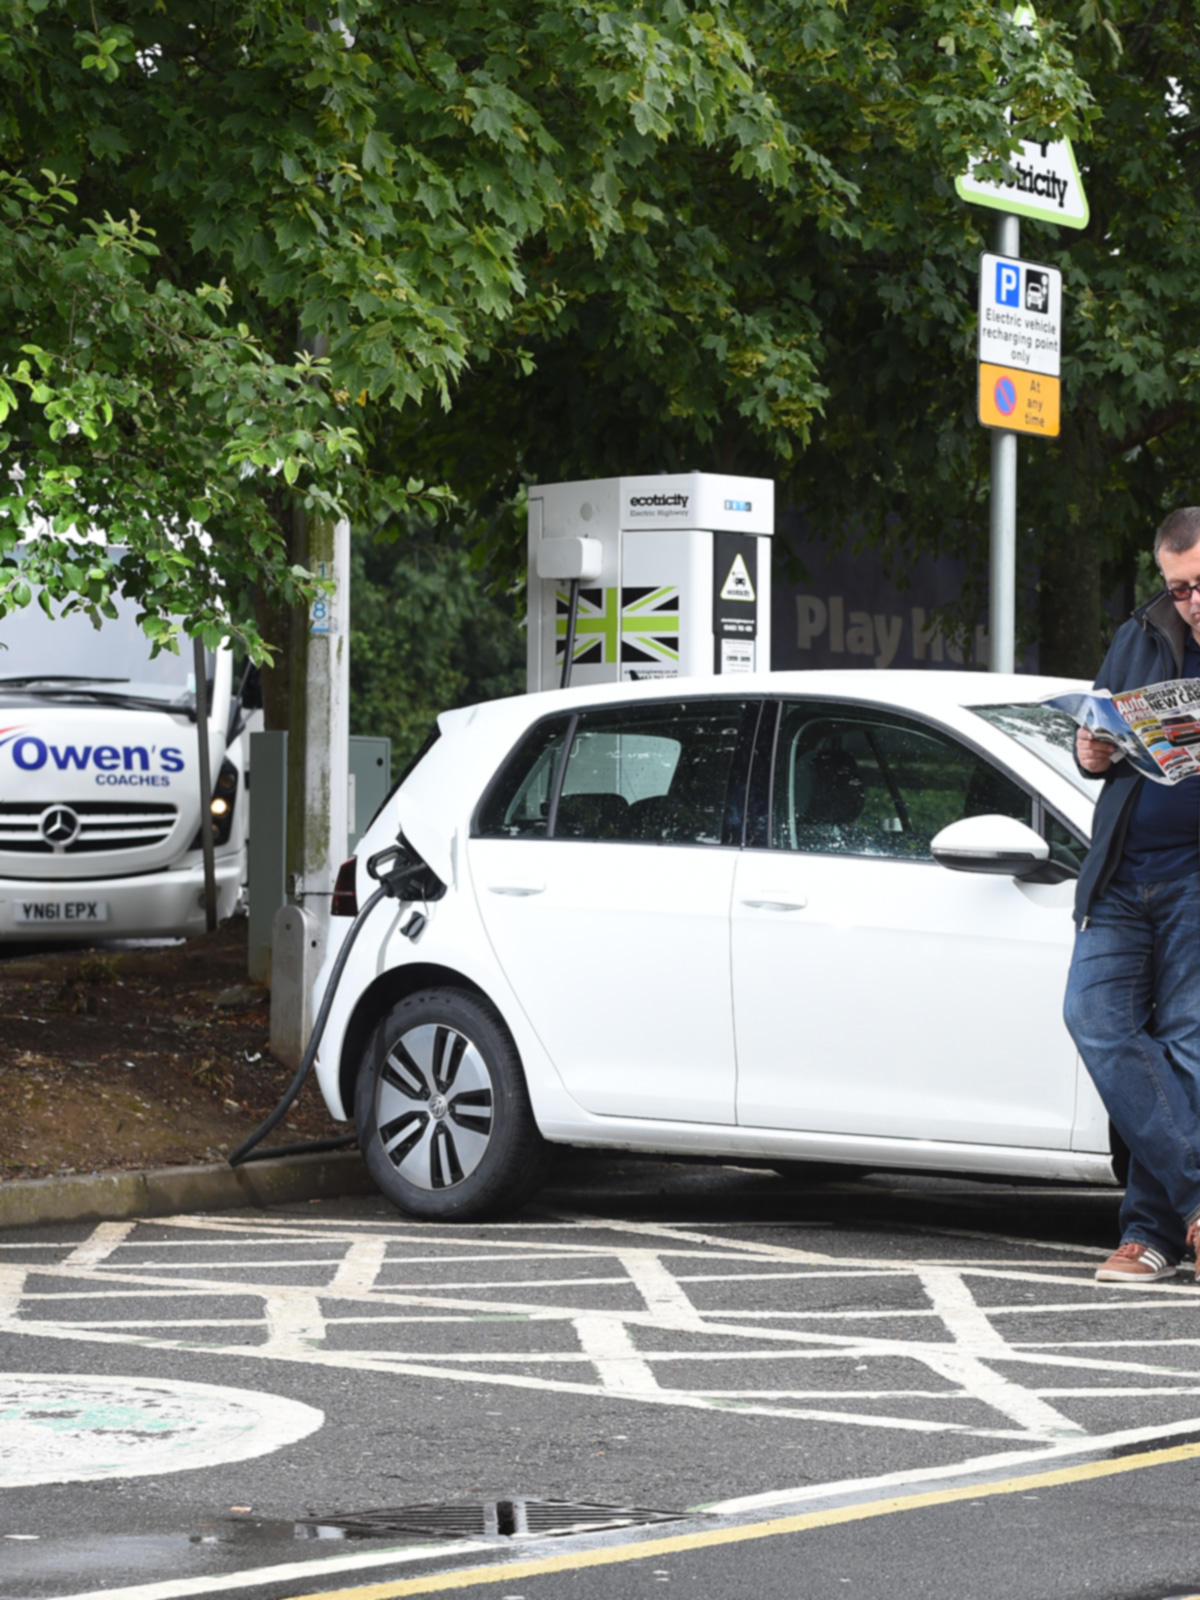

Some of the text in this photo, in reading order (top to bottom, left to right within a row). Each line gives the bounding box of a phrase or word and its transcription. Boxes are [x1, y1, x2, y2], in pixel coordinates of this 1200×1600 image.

[973, 159, 1068, 208] tricity
[1001, 268, 1017, 302] P
[985, 308, 1056, 335] Electric vehicle
[982, 327, 1058, 352] recharging point
[1011, 348, 1031, 364] only
[1030, 379, 1040, 393] At
[1027, 398, 1043, 413] any
[1025, 413, 1045, 428] time
[630, 493, 689, 508] ecotricity
[796, 595, 903, 668] Play
[1148, 697, 1179, 712] NEW
[12, 736, 185, 773] Owen's
[95, 774, 170, 787] COACHES
[23, 903, 97, 919] YN61 EPX
